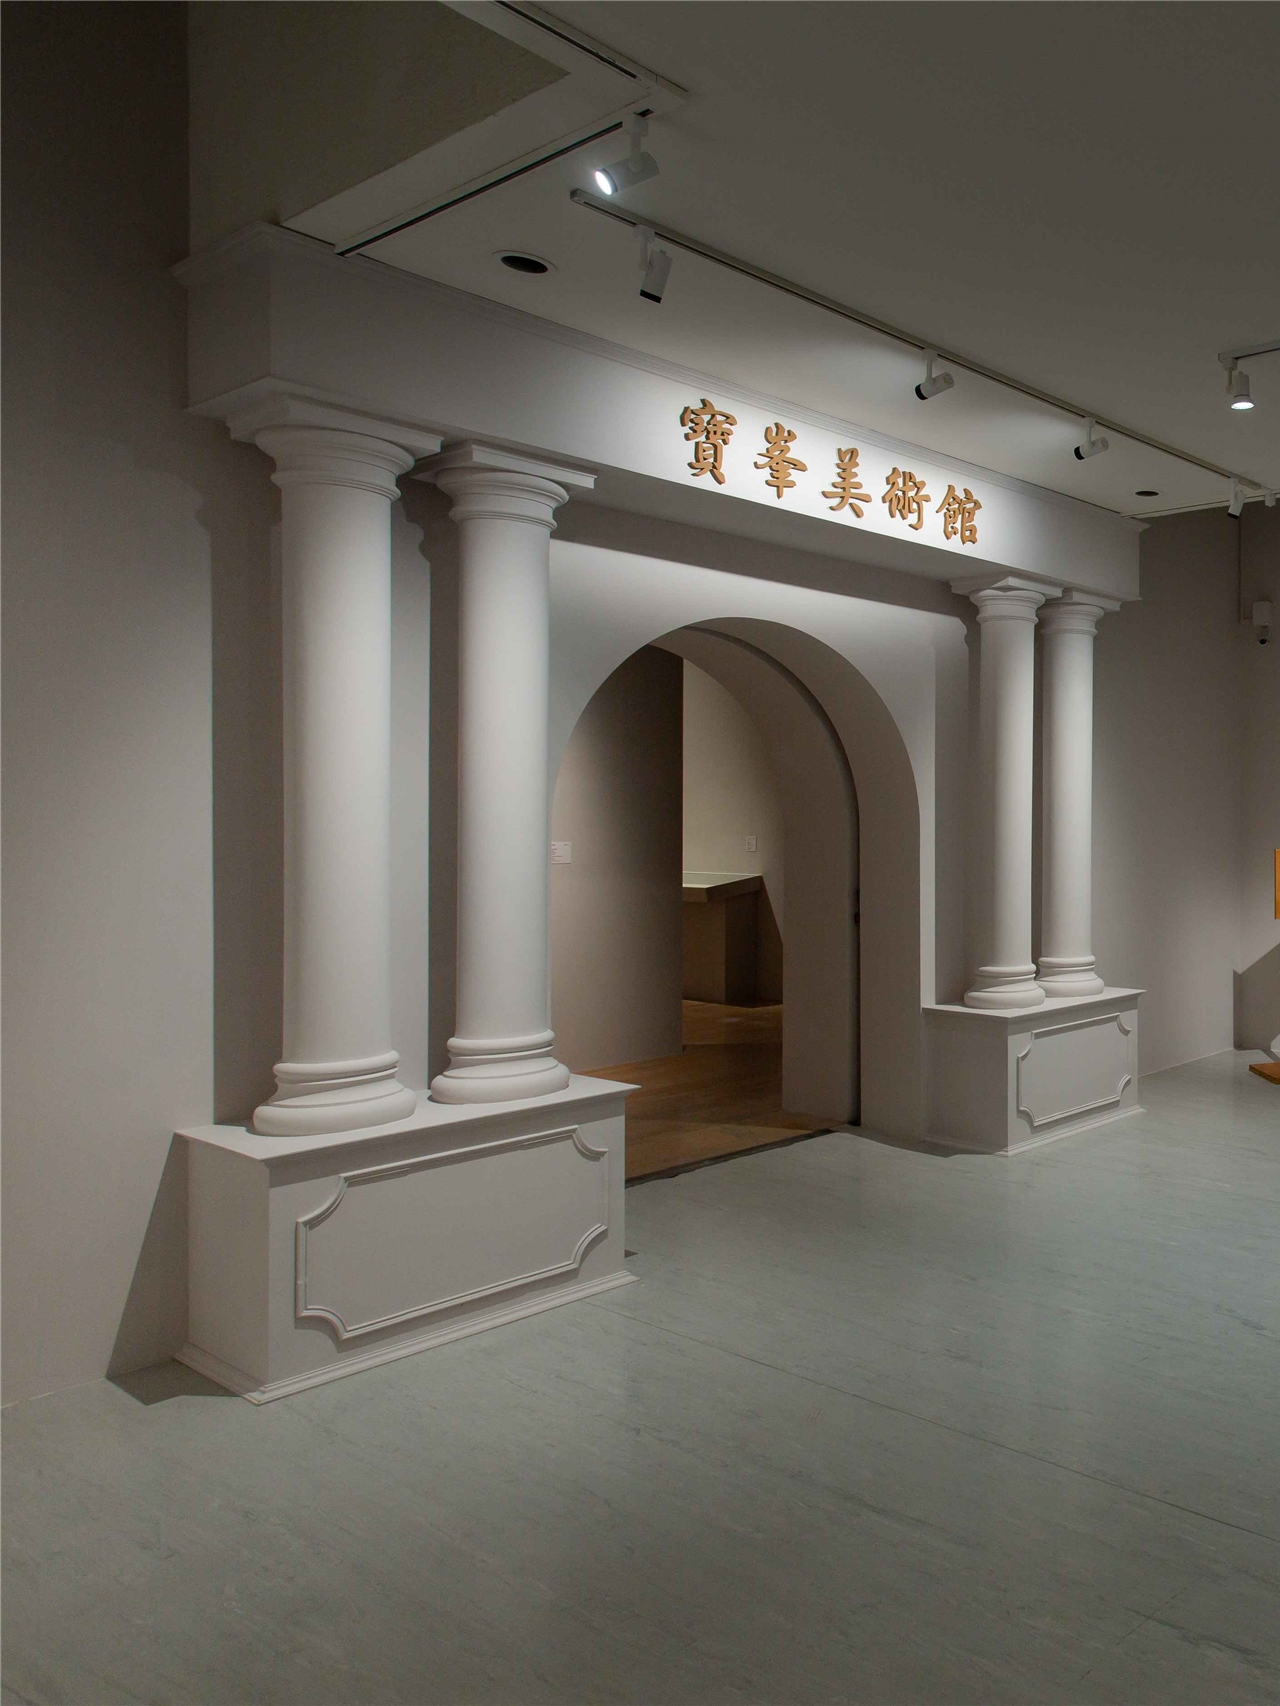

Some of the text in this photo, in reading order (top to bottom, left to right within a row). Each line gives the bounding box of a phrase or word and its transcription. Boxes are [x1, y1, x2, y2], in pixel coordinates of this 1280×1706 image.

[679, 398, 983, 545] 寶峯美術館
